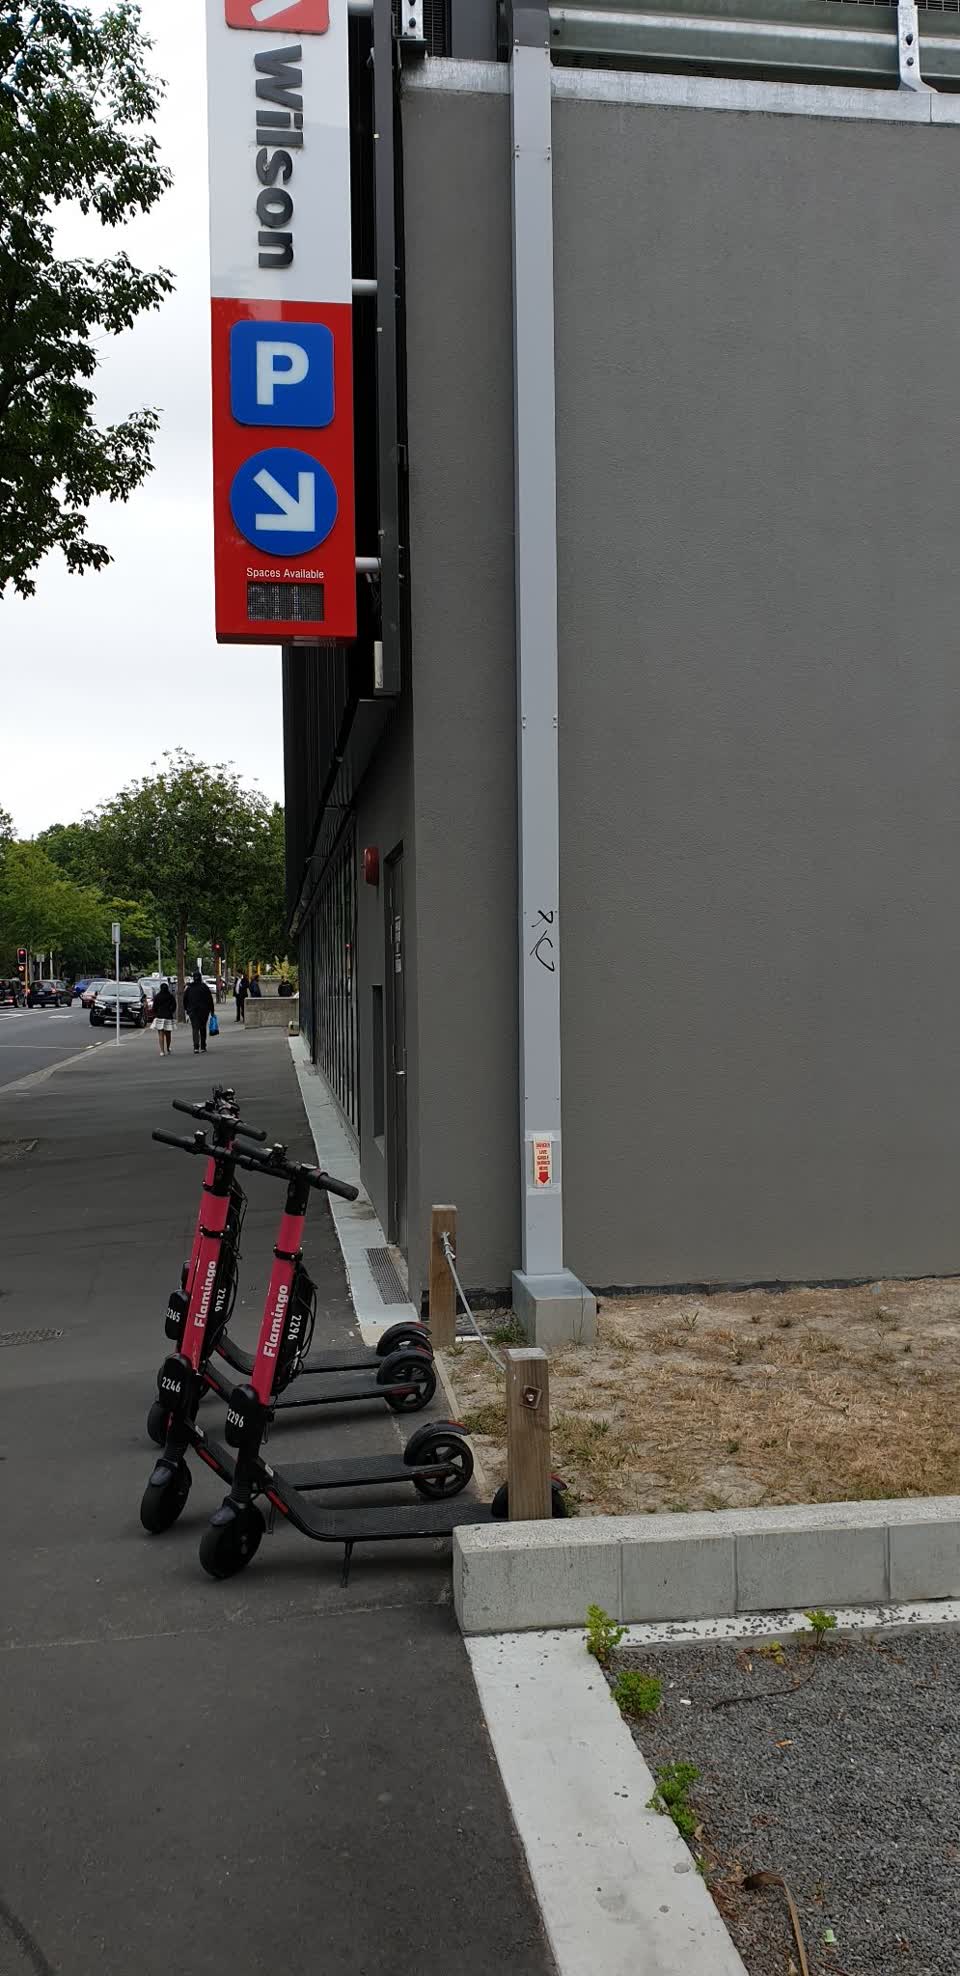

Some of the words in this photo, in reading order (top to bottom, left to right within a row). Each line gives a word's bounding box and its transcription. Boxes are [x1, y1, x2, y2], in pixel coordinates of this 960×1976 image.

[253, 43, 304, 270] Wilson
[255, 340, 310, 406] P
[246, 567, 281, 579] Spaces
[283, 568, 325, 579] Available
[194, 1260, 217, 1327] Flamingo
[214, 1287, 227, 1312] 2246
[263, 1284, 289, 1357] Flamingo
[287, 1314, 302, 1340] 2296
[161, 1376, 182, 1393] 2246
[227, 1408, 244, 1428] 2296
